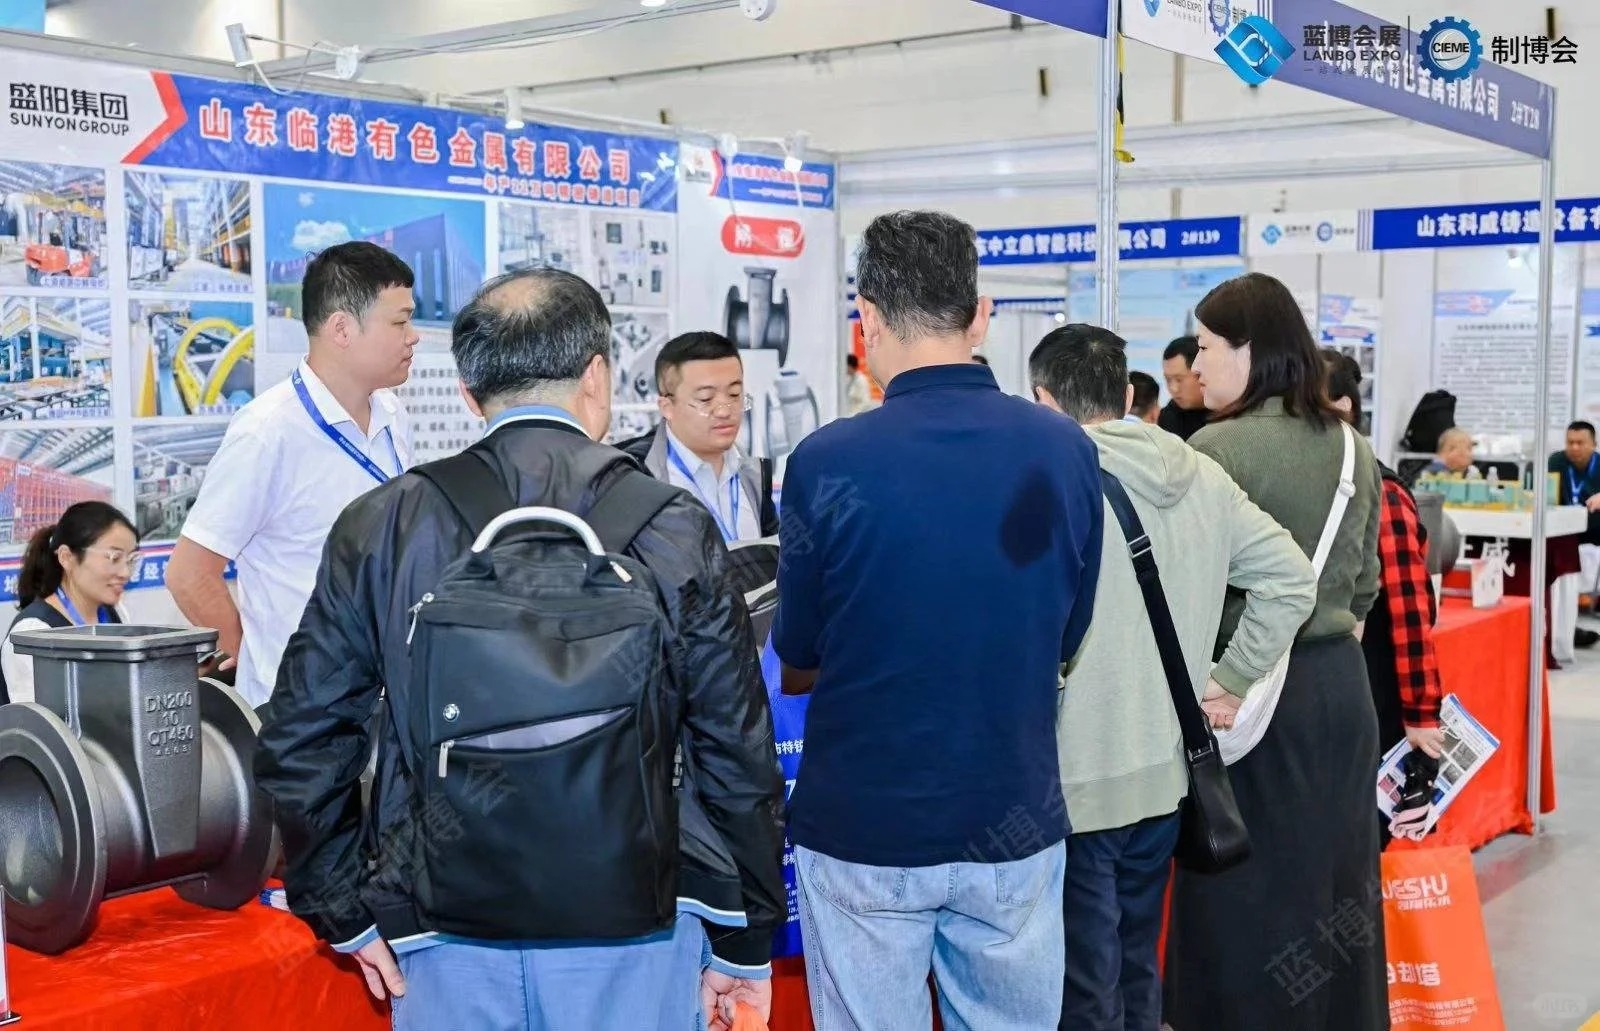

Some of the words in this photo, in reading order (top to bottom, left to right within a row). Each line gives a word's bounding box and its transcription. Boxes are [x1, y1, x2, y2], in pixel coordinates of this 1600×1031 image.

[9, 82, 129, 122] 盛阳集团
[10, 112, 77, 132] SUNYON
[79, 119, 130, 137] GROUP
[200, 97, 631, 186] 山东临港有色金属有限公司
[143, 690, 193, 714] DN200
